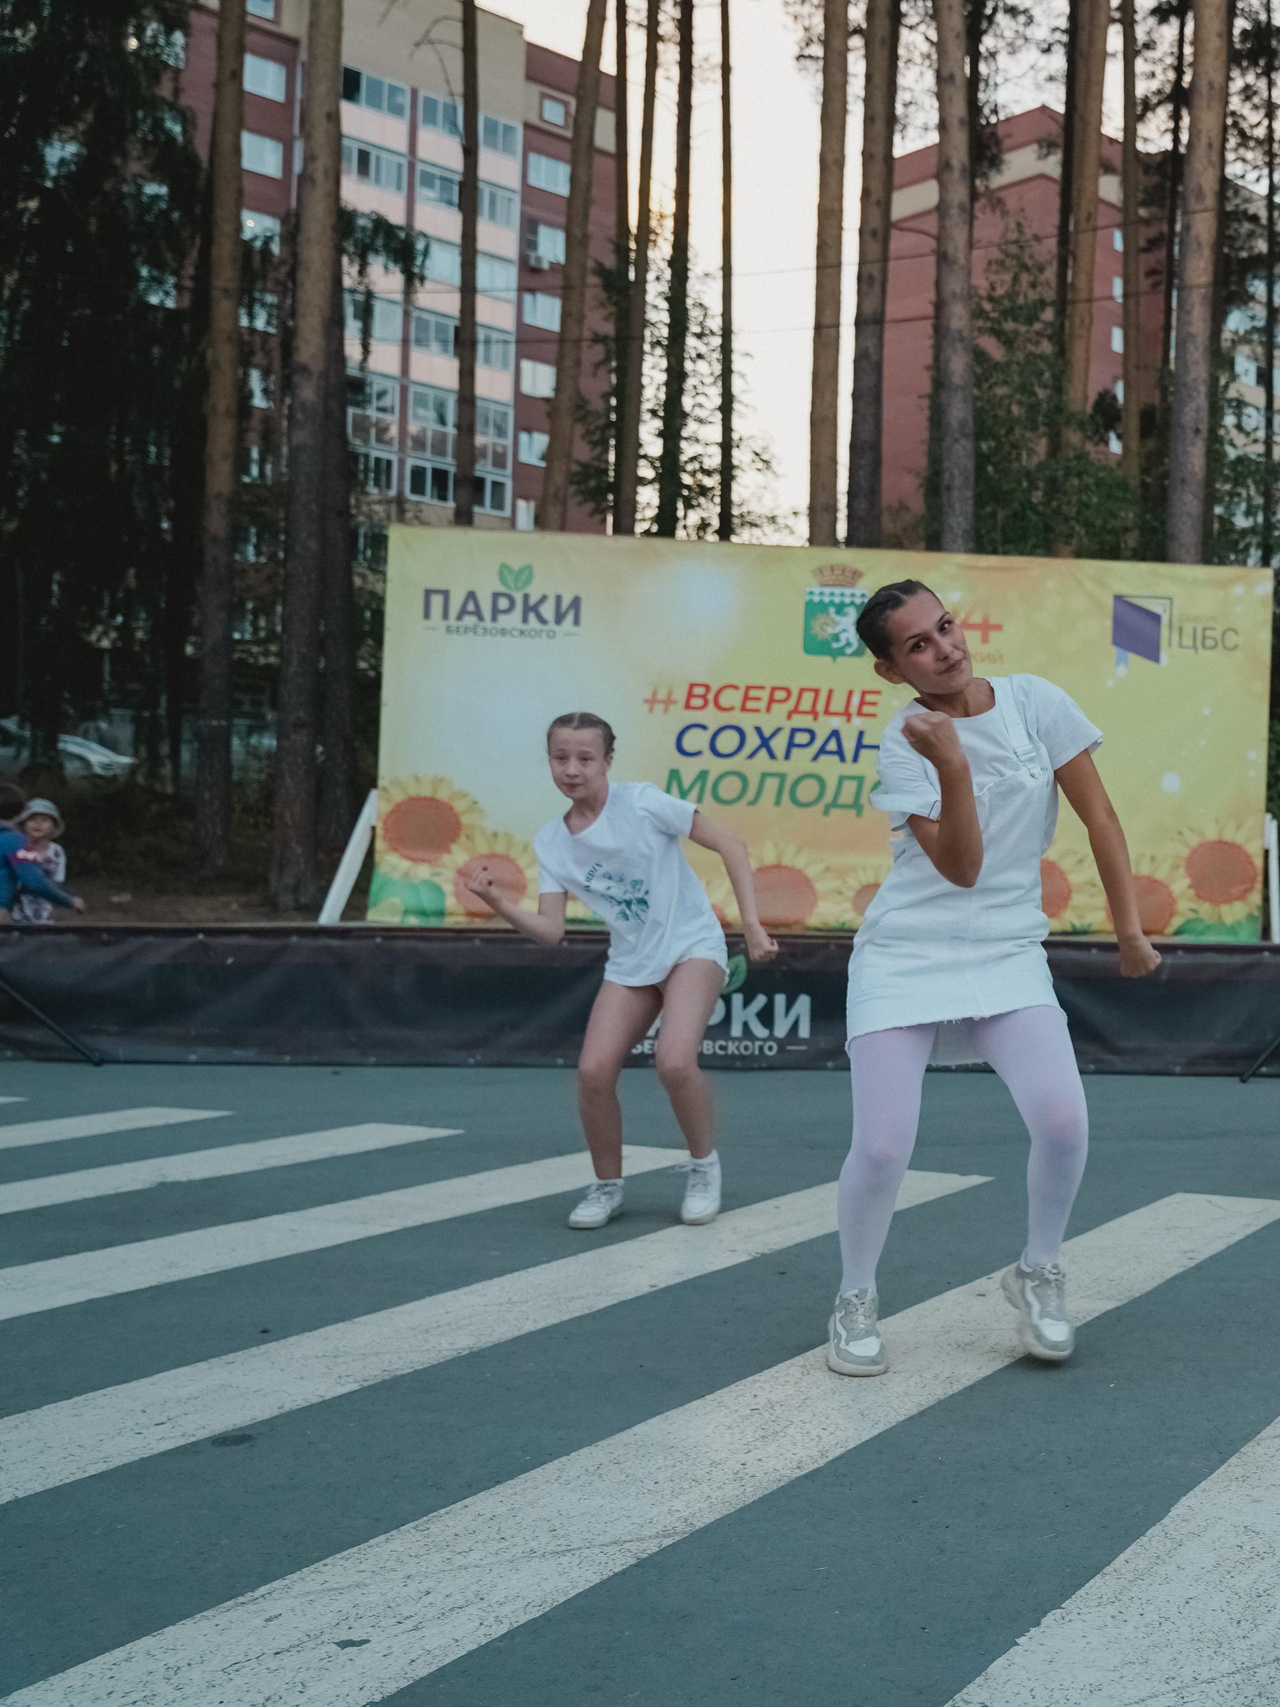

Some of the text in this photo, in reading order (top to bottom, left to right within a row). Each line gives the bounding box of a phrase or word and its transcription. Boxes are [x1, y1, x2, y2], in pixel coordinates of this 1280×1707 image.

[423, 589, 582, 627] ПАРКИ
[445, 624, 557, 640] БЕРЁЗОВСКОГО
[1178, 626, 1240, 655] ЦБС
[665, 768, 882, 817] МОЛОД
